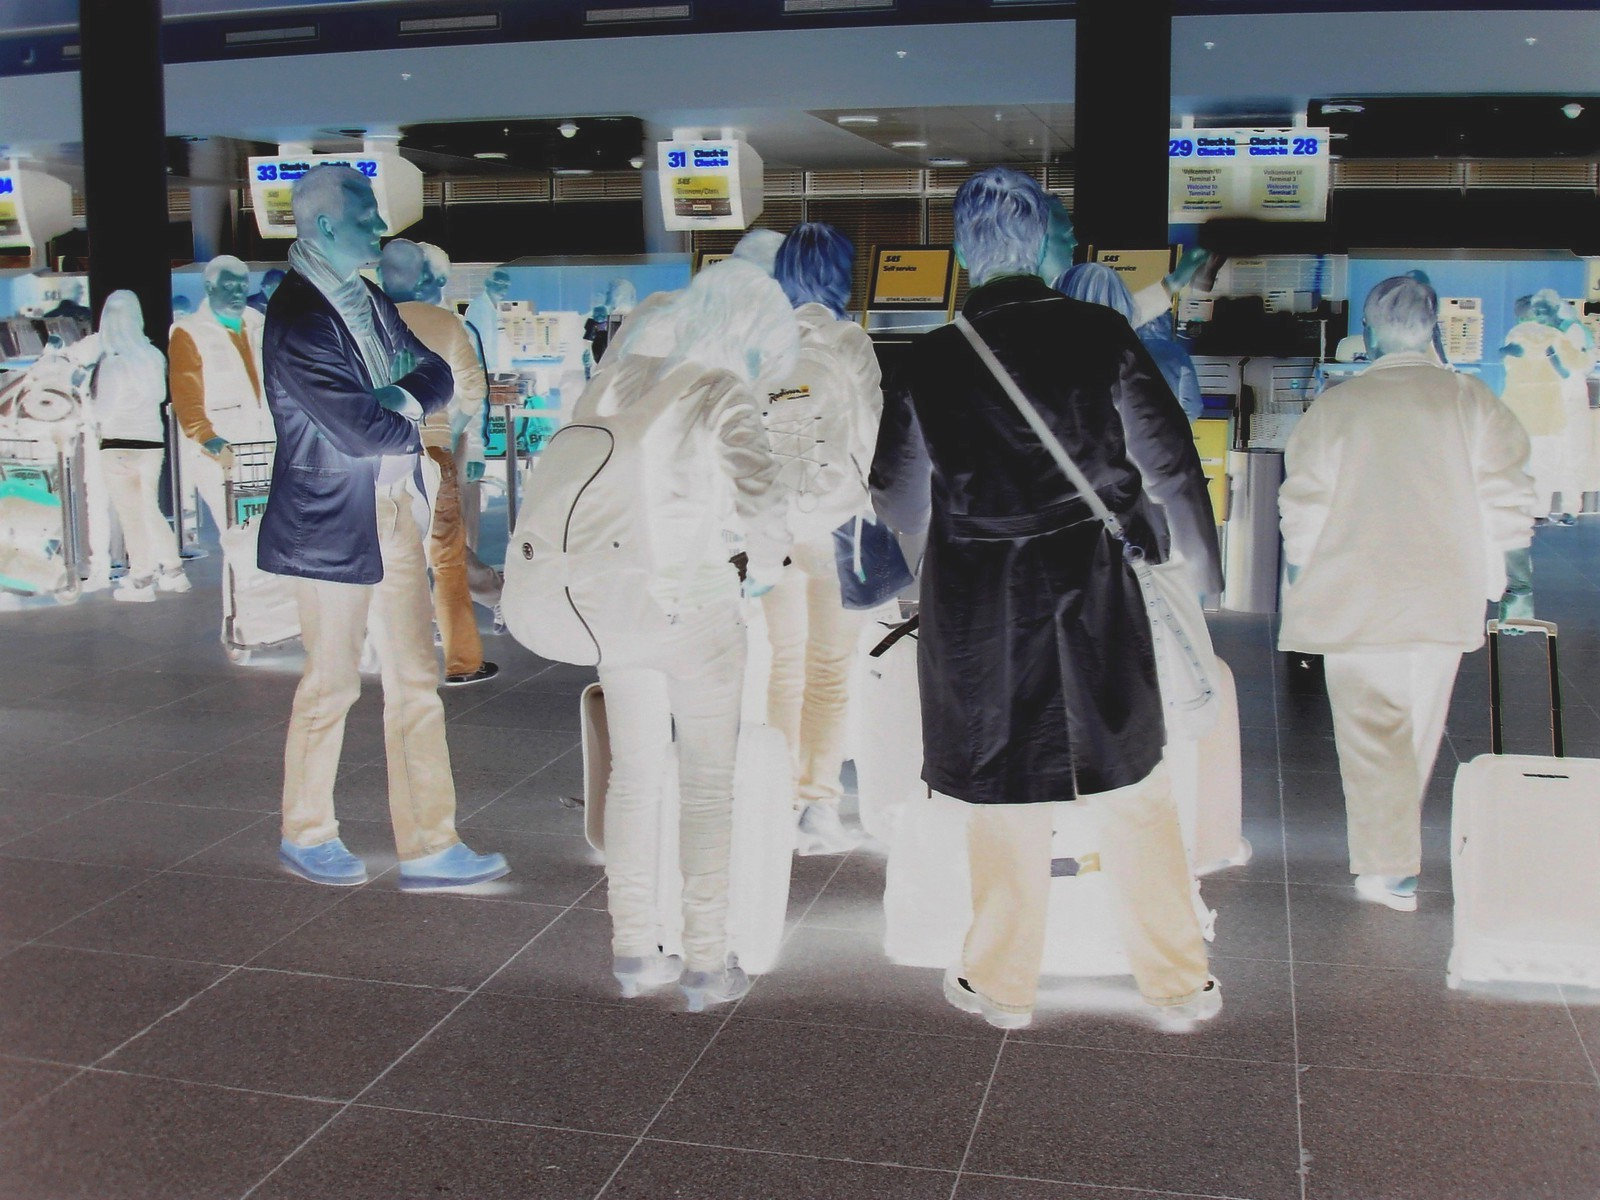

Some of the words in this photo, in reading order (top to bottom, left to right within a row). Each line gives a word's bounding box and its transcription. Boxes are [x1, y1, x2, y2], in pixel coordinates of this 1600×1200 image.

[1197, 138, 1236, 146] Check-in
[1250, 137, 1288, 146] Check-in
[1169, 139, 1193, 156] 29
[1250, 147, 1288, 155] Check-in
[1292, 138, 1318, 155] 28
[694, 149, 729, 158] Check-in
[1197, 147, 1236, 156] Check-in
[668, 152, 687, 168] 31
[694, 158, 729, 167] Check-in
[257, 165, 278, 181] 33
[356, 161, 378, 177] 32
[1102, 255, 1120, 263] SAS
